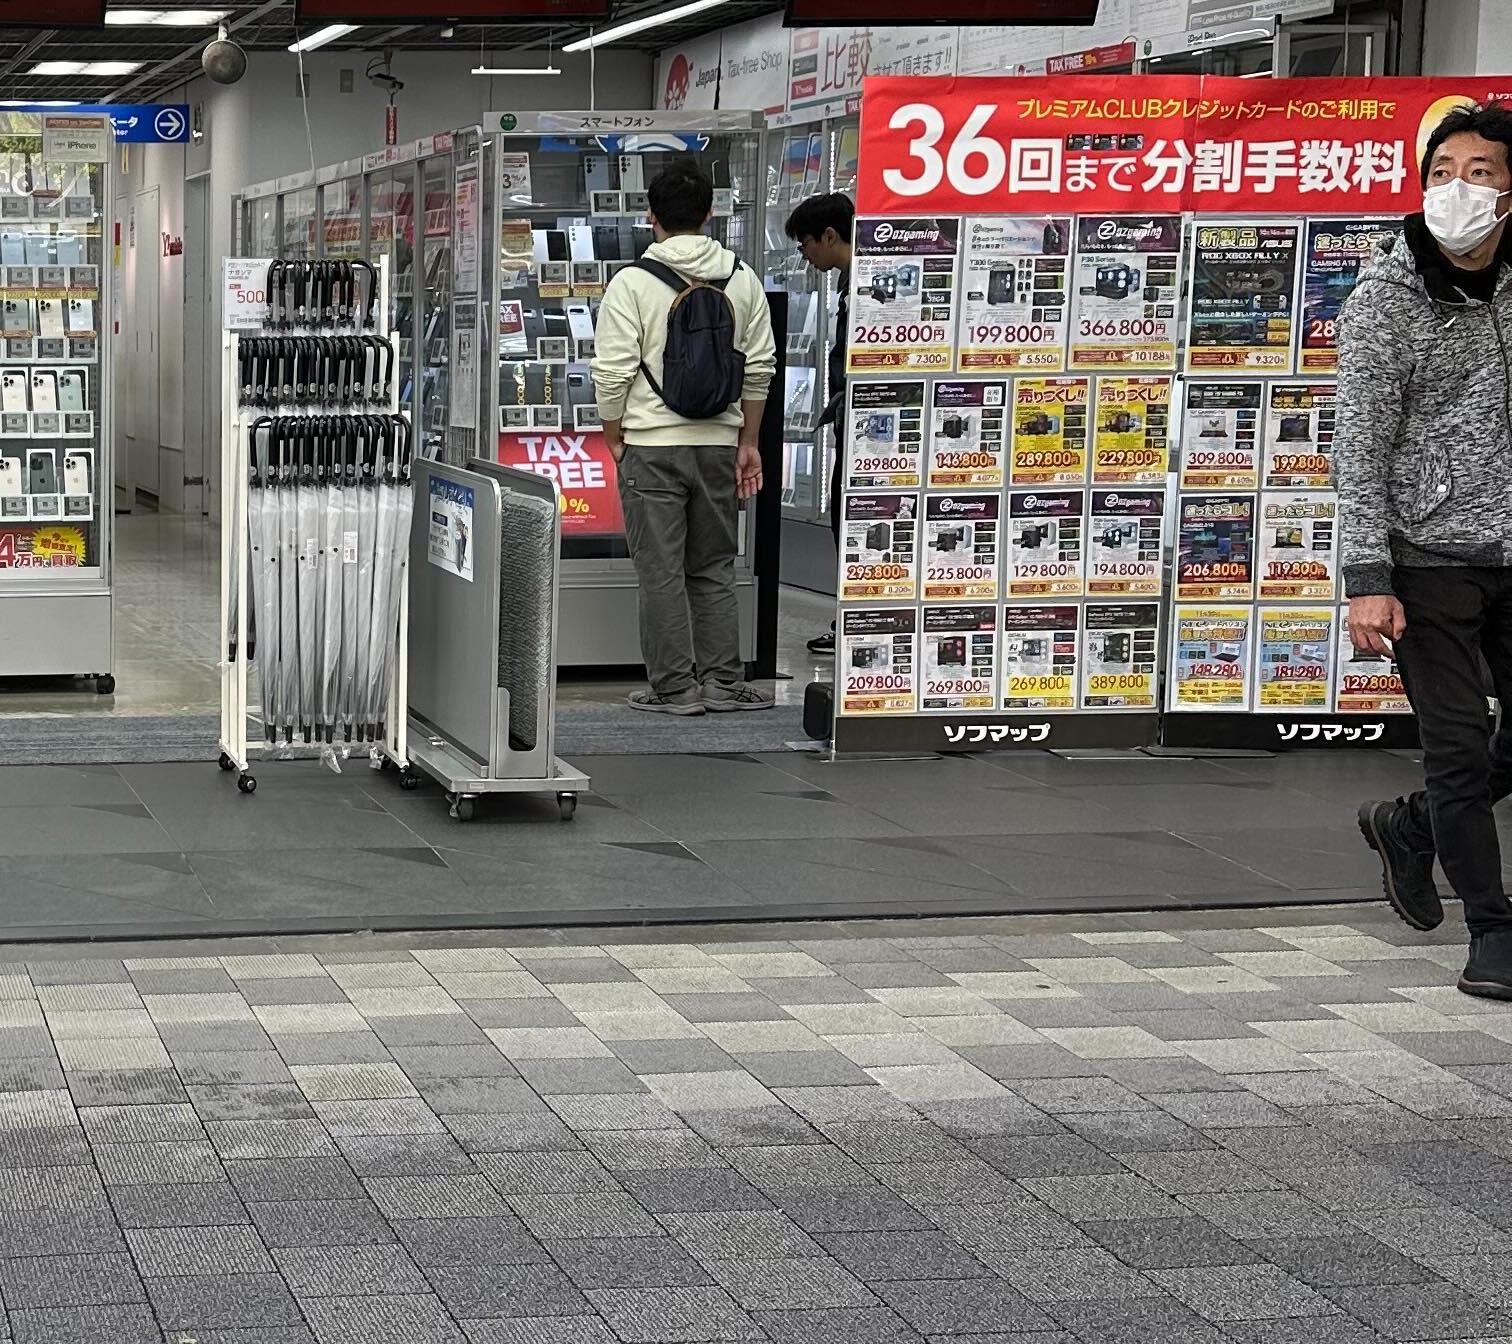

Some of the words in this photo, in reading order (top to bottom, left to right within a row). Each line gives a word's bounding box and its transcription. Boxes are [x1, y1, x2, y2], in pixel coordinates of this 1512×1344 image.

[1049, 58, 1065, 73] TAX
[1065, 55, 1084, 71] FREE
[1016, 98, 1397, 121] プレミアムCLUBクレジットカードのご利用で
[580, 117, 655, 128] スマートフォン
[882, 103, 1407, 197] 36回まで分割手数料
[1198, 228, 1258, 248] 新製品
[1260, 239, 1293, 248] ASUS
[1201, 252, 1222, 260] ROG
[1224, 252, 1253, 260] XBOX
[500, 303, 513, 313] AX
[854, 325, 945, 345] 265,800円
[968, 325, 1055, 345] 199,800円
[1079, 319, 1166, 337] 366,800円
[1017, 387, 1085, 404] 売りつくし!!
[1099, 386, 1167, 403] 売りつくし!!
[518, 435, 591, 462] TAX
[513, 461, 606, 488] REE
[944, 722, 1051, 743] ソフマップ
[1276, 723, 1385, 741] ソフマップ
